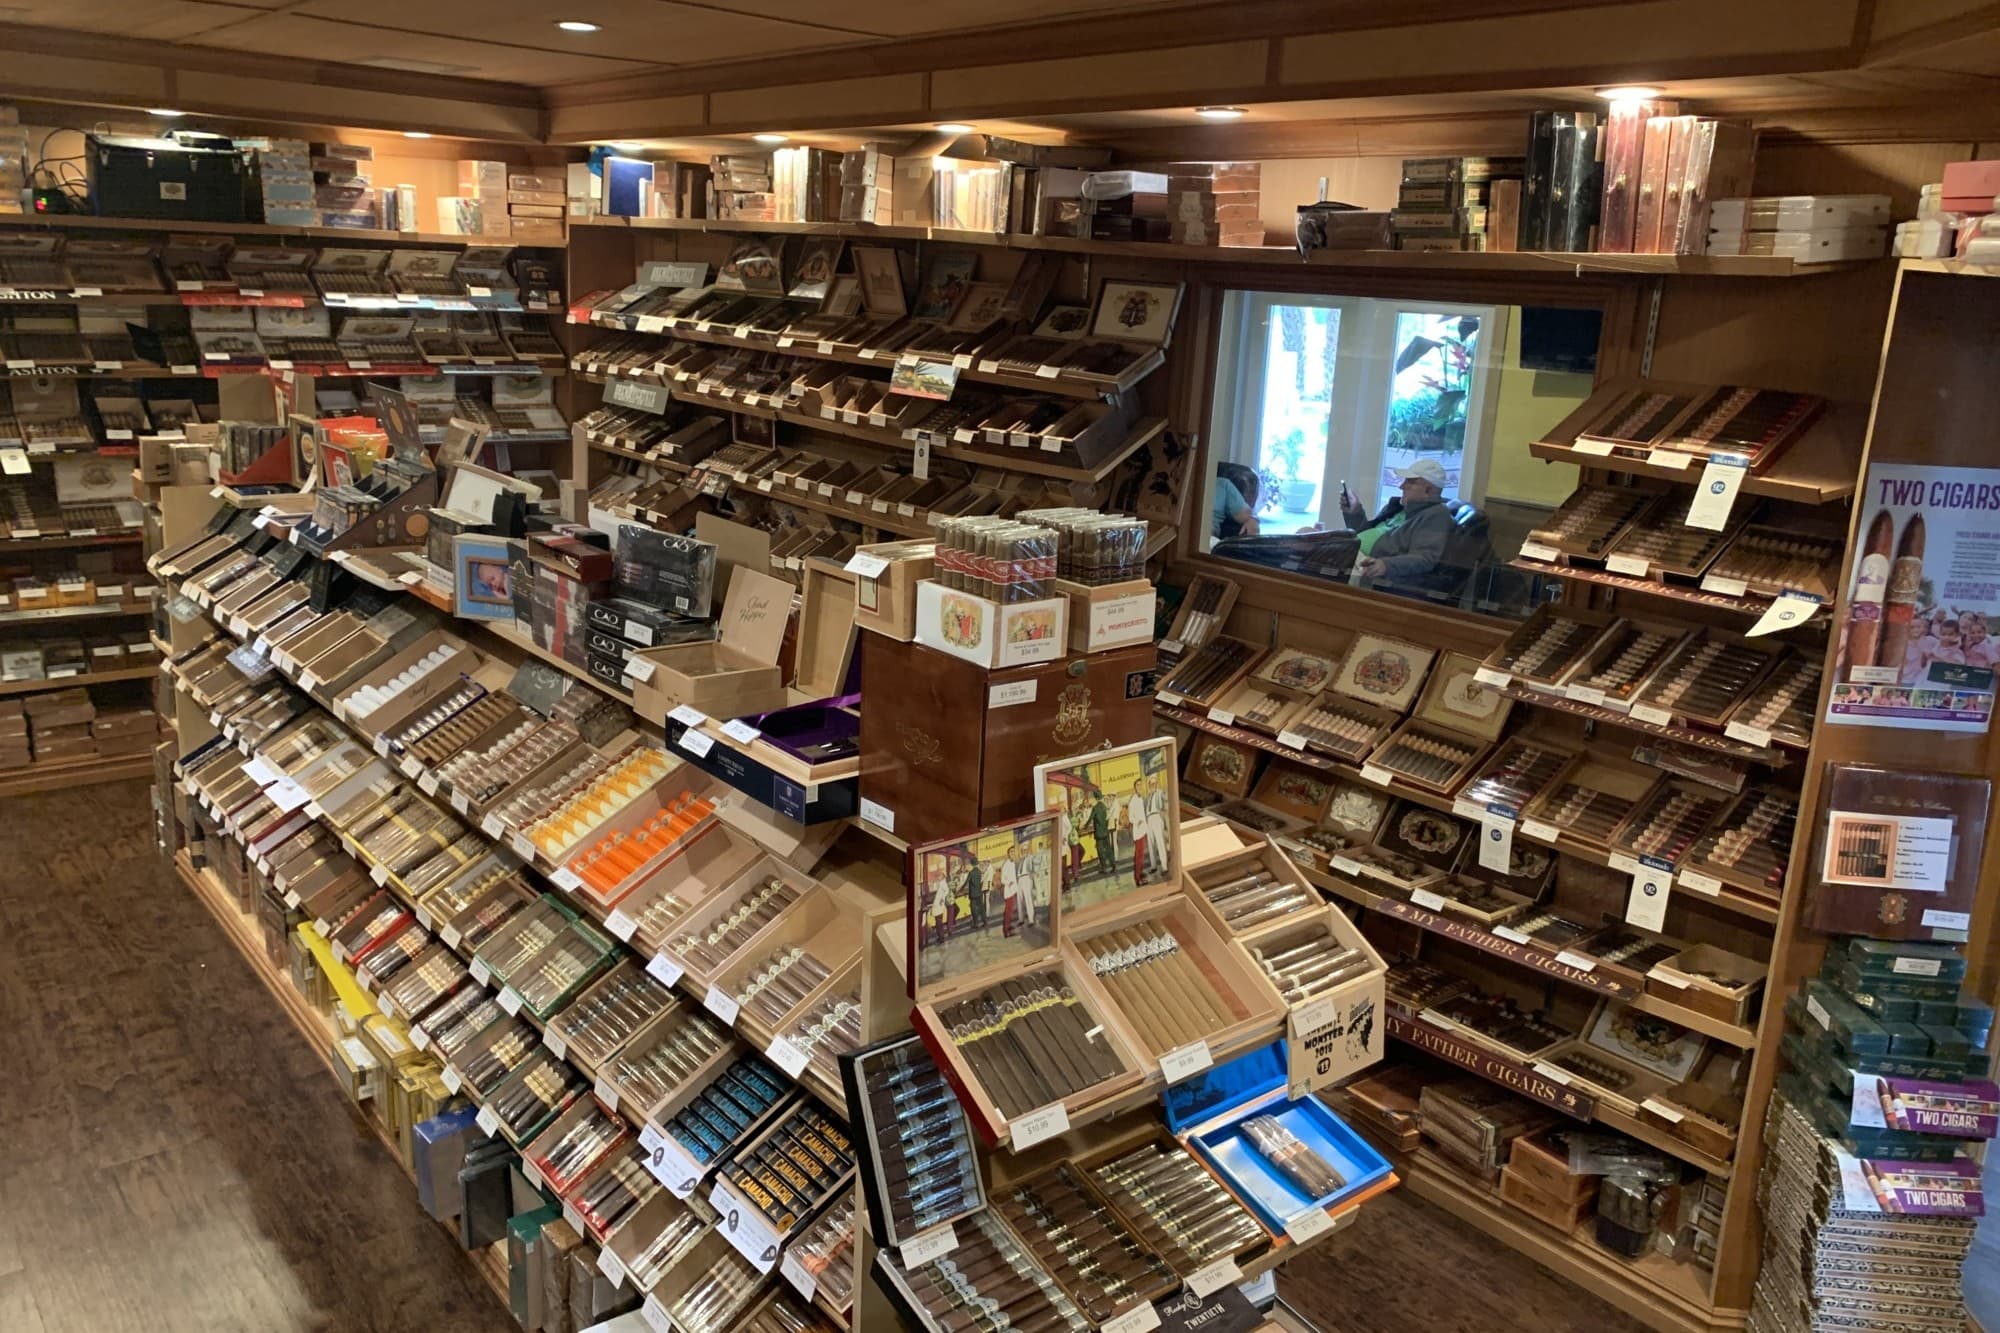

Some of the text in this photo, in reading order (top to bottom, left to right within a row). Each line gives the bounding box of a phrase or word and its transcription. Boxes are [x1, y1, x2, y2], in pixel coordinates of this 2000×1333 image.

[9, 366, 78, 377] ASHTON
[1880, 479, 2000, 510] TWO CIGARS
[663, 538, 689, 552] CAO
[594, 609, 618, 625] CAO
[592, 635, 615, 651] CAO
[594, 661, 615, 677] CAO
[1513, 688, 1729, 749] MY FATHER CIGARS
[1247, 737, 1305, 760] CIGARS
[1409, 910, 1600, 986] MY FATHER CIGARS
[1304, 1026, 1344, 1051] MONSTER
[1411, 1028, 1479, 1068] FATHER
[1486, 1061, 1557, 1102] CIGARS
[1915, 1111, 1979, 1129] TWO CIGARS
[788, 1146, 823, 1179] CAMACHO
[801, 1133, 836, 1165] CAMACHO
[760, 1171, 794, 1205] CAMACHO
[773, 1158, 808, 1190] CAMACHO
[739, 1176, 774, 1210] CAMACHO
[1904, 1190, 1966, 1208] TWO CIGARS
[1184, 1302, 1226, 1330] TWENTIETH
